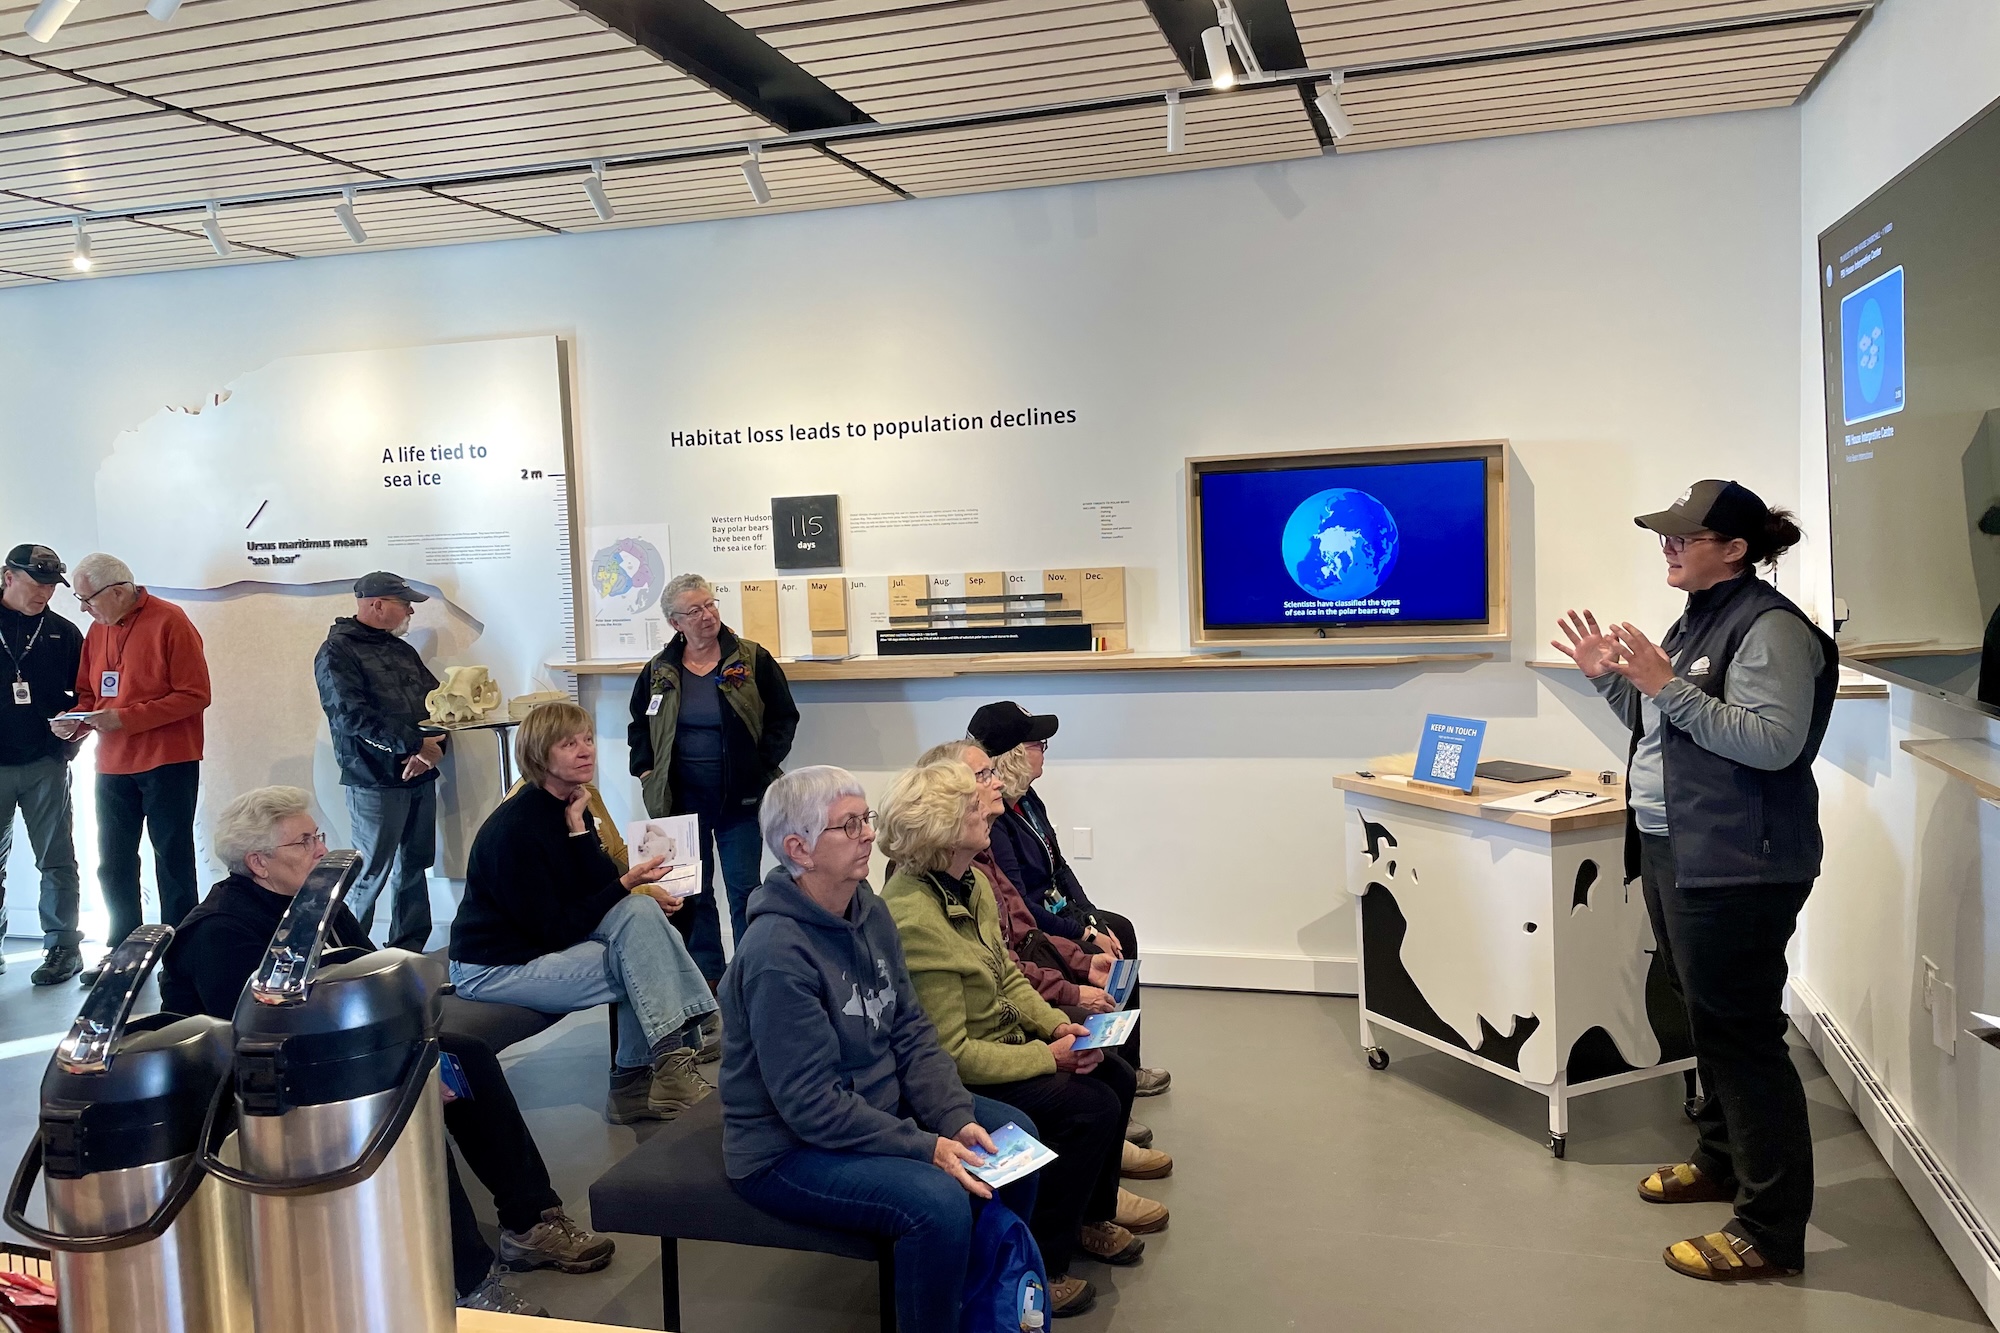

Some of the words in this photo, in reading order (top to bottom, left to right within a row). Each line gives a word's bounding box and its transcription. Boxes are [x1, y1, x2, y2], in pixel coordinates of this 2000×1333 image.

[670, 429, 742, 447] Habitat
[747, 426, 784, 443] loss
[789, 421, 841, 441] leads
[846, 422, 867, 437] to
[873, 413, 984, 441] population
[990, 407, 1077, 428] declines
[382, 448, 394, 463] A
[398, 446, 425, 462] life
[430, 442, 464, 461] tied
[468, 444, 488, 459] to
[383, 474, 412, 488] sea
[417, 470, 441, 486] ice
[520, 468, 529, 480] 2
[530, 470, 543, 480] m
[711, 515, 743, 524] Western
[744, 514, 772, 522] Hudson
[712, 526, 726, 534] Bay
[727, 525, 747, 534] polar
[791, 514, 823, 537] 115
[247, 541, 277, 551] Ursus
[278, 538, 331, 550] maritimus
[333, 538, 368, 548] means
[712, 535, 731, 543] have
[732, 534, 751, 542] been
[797, 541, 816, 551] days
[744, 584, 762, 592] Mar.
[781, 583, 798, 591] Apr.
[811, 582, 828, 591] May
[851, 581, 867, 590] Jun.
[892, 579, 906, 588] Jul.
[933, 578, 952, 587] Aug.
[969, 576, 986, 585] Sep.
[1009, 575, 1026, 583] Oct.
[1047, 573, 1067, 582] Nov.
[1085, 572, 1104, 580] Dec.
[1335, 599, 1367, 607] classified
[1381, 599, 1401, 608] types
[1306, 608, 1317, 616] ice
[1338, 607, 1358, 617] polar
[1358, 607, 1378, 615] bears
[1379, 607, 1400, 616] range
[1430, 723, 1446, 732] KEEP
[1446, 725, 1454, 734] IN
[1455, 726, 1478, 737] TOUCH
